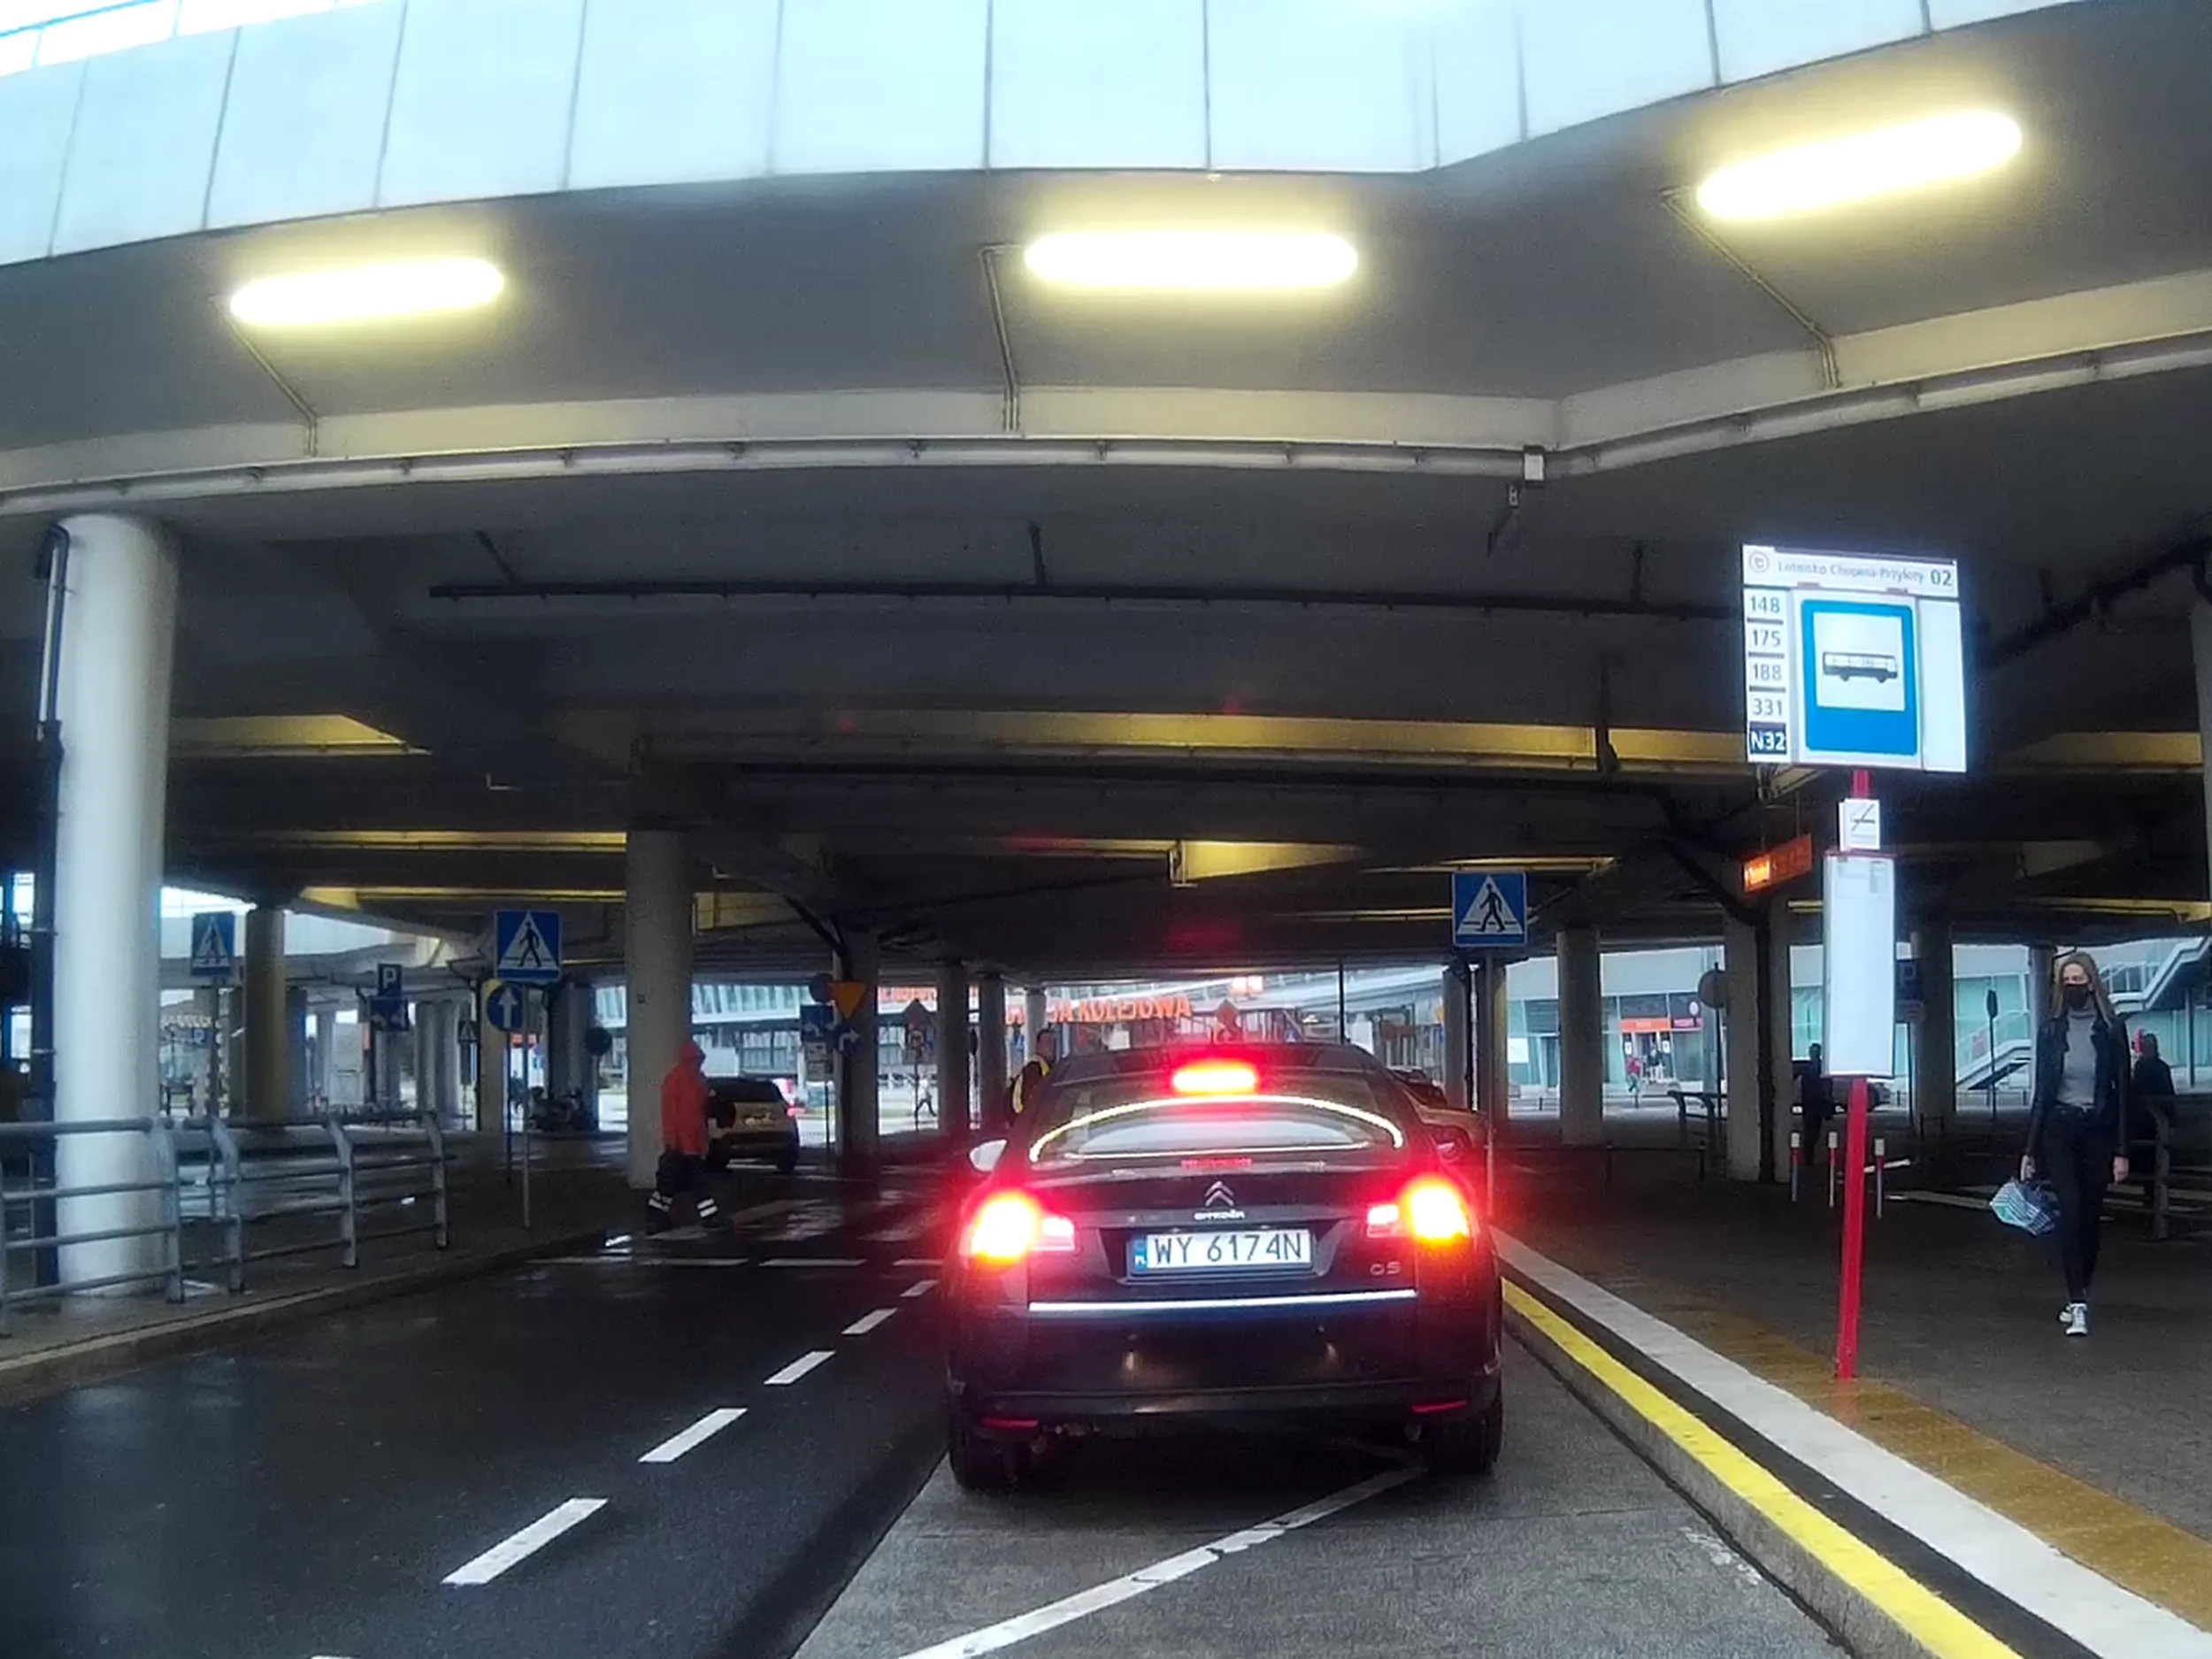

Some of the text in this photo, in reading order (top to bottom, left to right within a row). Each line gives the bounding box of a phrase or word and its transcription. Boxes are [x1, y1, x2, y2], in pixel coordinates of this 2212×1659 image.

[1930, 568, 1954, 588] 02
[1749, 595, 1781, 614] 148
[1752, 629, 1782, 648] 175
[1751, 663, 1783, 681] 188
[1753, 697, 1784, 717] 331
[1749, 731, 1786, 751] N32
[382, 968, 397, 988] P
[1078, 994, 1193, 1023] KOLEJOWA
[1154, 1233, 1303, 1264] WY 6174N
